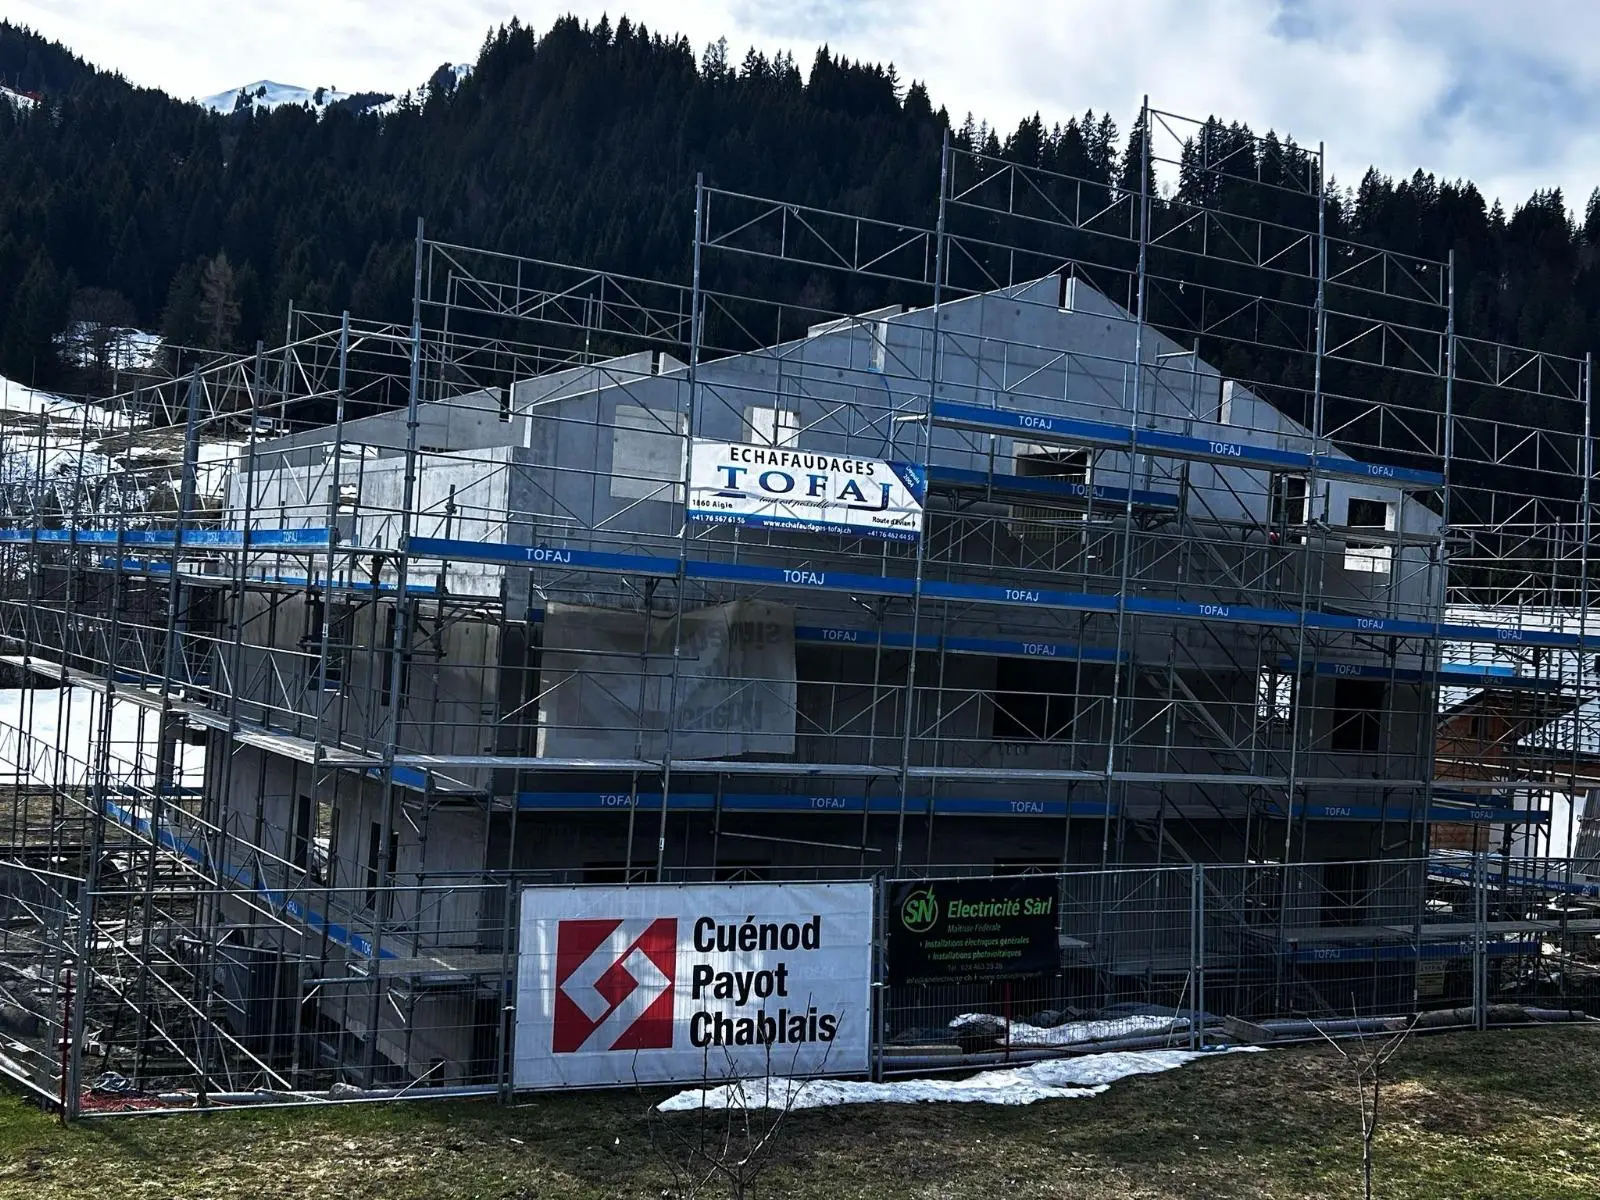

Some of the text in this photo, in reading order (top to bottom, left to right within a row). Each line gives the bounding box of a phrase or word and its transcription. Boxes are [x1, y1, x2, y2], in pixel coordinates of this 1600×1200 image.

[1018, 415, 1053, 430] TOFAJ
[1208, 441, 1241, 457] TOFAJ
[730, 447, 875, 476] ECHAFAUDAGES
[1367, 465, 1394, 478] TOFAJ
[716, 465, 894, 511] TOFAJ
[1071, 483, 1105, 497] TOFAJ
[692, 499, 733, 509] 1860 Aigle
[705, 514, 714, 522] 76
[715, 515, 727, 523] 567
[872, 516, 890, 524] Route
[525, 547, 571, 564] TOFAJ
[783, 570, 826, 586] TOFAJ
[1005, 589, 1039, 602] TOFAJ
[1199, 604, 1230, 617] TOFAJ
[1356, 618, 1384, 630] TOFAJ
[822, 629, 857, 642] TOFAJ
[1496, 629, 1523, 641] TOFAJ
[1023, 643, 1056, 656] TOFAJ
[1334, 663, 1361, 676] TOFAJ
[1480, 675, 1504, 686] TOFAJ
[600, 794, 640, 808] TOFAJ
[810, 796, 846, 810] TOFAJ
[1010, 801, 1044, 814] TOFAJ
[1324, 806, 1351, 817] TOFAJ
[1470, 809, 1494, 819] TOFAJ
[947, 896, 1053, 919] Electricité Sàrl
[693, 914, 822, 953] Cuénod
[924, 939, 964, 949] Installations
[932, 951, 972, 961] Installations
[1313, 948, 1340, 959] TOFAJ
[691, 962, 788, 1007] Payot
[689, 1007, 837, 1048] Chablais
